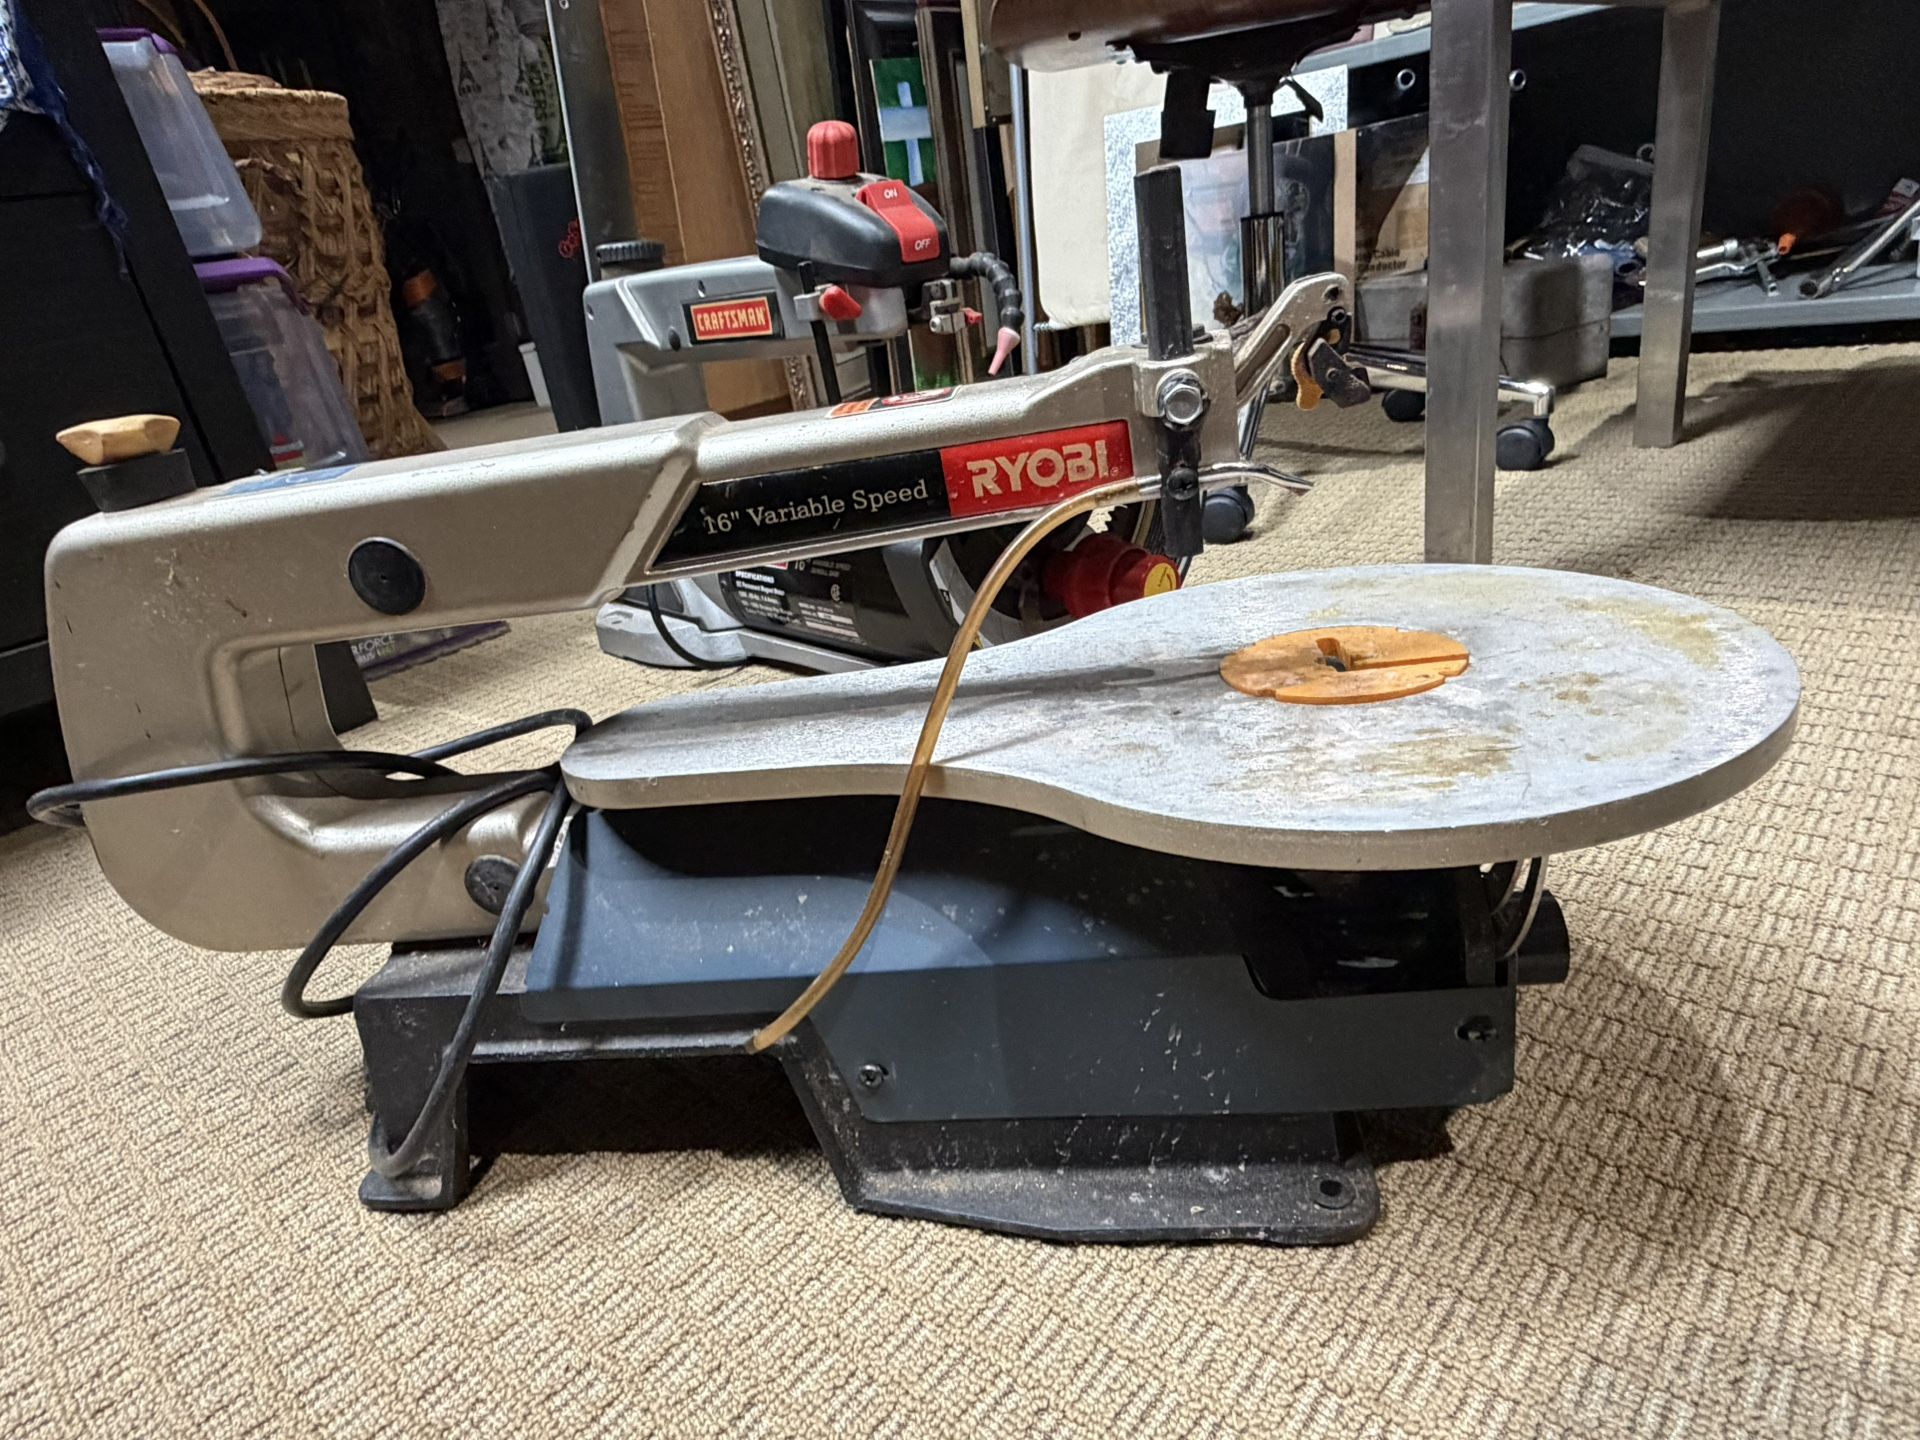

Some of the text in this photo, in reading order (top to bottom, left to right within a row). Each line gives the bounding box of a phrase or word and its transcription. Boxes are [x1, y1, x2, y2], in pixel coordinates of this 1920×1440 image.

[883, 187, 898, 200] ON
[914, 238, 932, 251] OFF
[696, 308, 766, 332] CRAFTSMAN
[966, 439, 1109, 499] RYOBI
[746, 495, 846, 527] Variable
[851, 479, 929, 513] Speed
